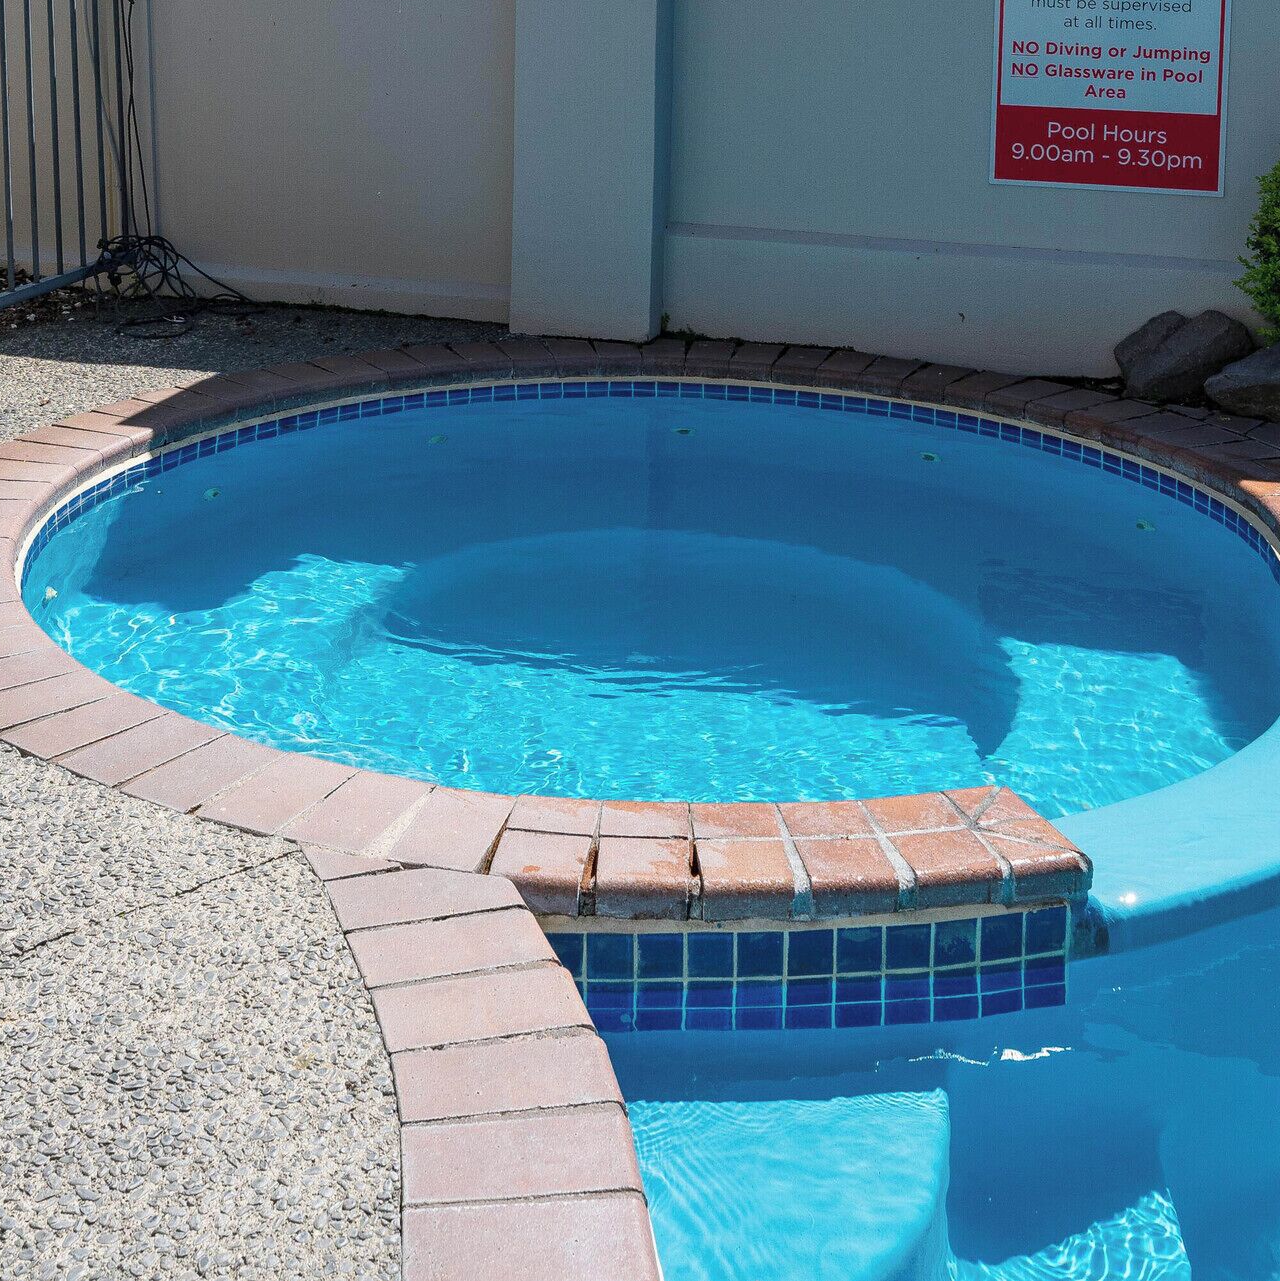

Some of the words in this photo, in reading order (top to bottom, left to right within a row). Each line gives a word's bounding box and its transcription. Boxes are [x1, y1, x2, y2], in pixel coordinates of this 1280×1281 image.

[1102, 0, 1192, 14] supervised
[1063, 16, 1079, 29] at
[1084, 15, 1102, 29] all
[1108, 16, 1157, 31] times.
[1012, 40, 1040, 56] NO
[1045, 41, 1102, 60] Diving
[1108, 47, 1127, 58] or
[1132, 46, 1211, 64] Jumping
[1011, 62, 1039, 77] NO
[1045, 63, 1135, 81] Glassware
[1140, 67, 1156, 81] in
[1163, 69, 1203, 84] Pool
[1084, 84, 1126, 99] Area
[1047, 121, 1095, 141] Pool
[1103, 124, 1168, 145] Hours
[1011, 142, 1094, 164] 9.00am
[1117, 148, 1203, 171] 9.30pm
